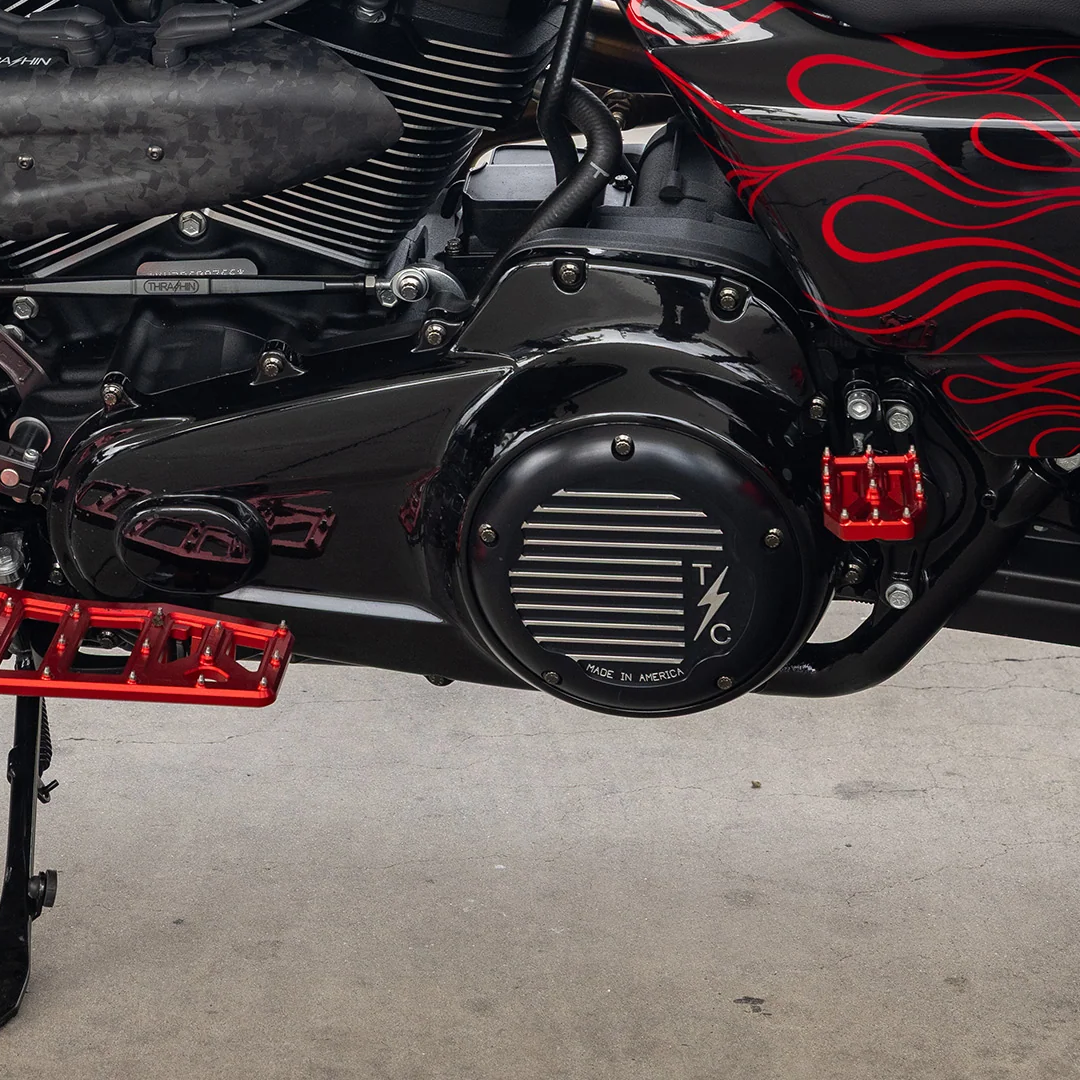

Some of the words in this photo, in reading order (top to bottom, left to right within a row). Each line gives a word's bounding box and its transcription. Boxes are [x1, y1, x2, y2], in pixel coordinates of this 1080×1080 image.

[586, 663, 615, 680] MADE
[620, 672, 633, 682] IN
[639, 668, 684, 682] AMERICA
